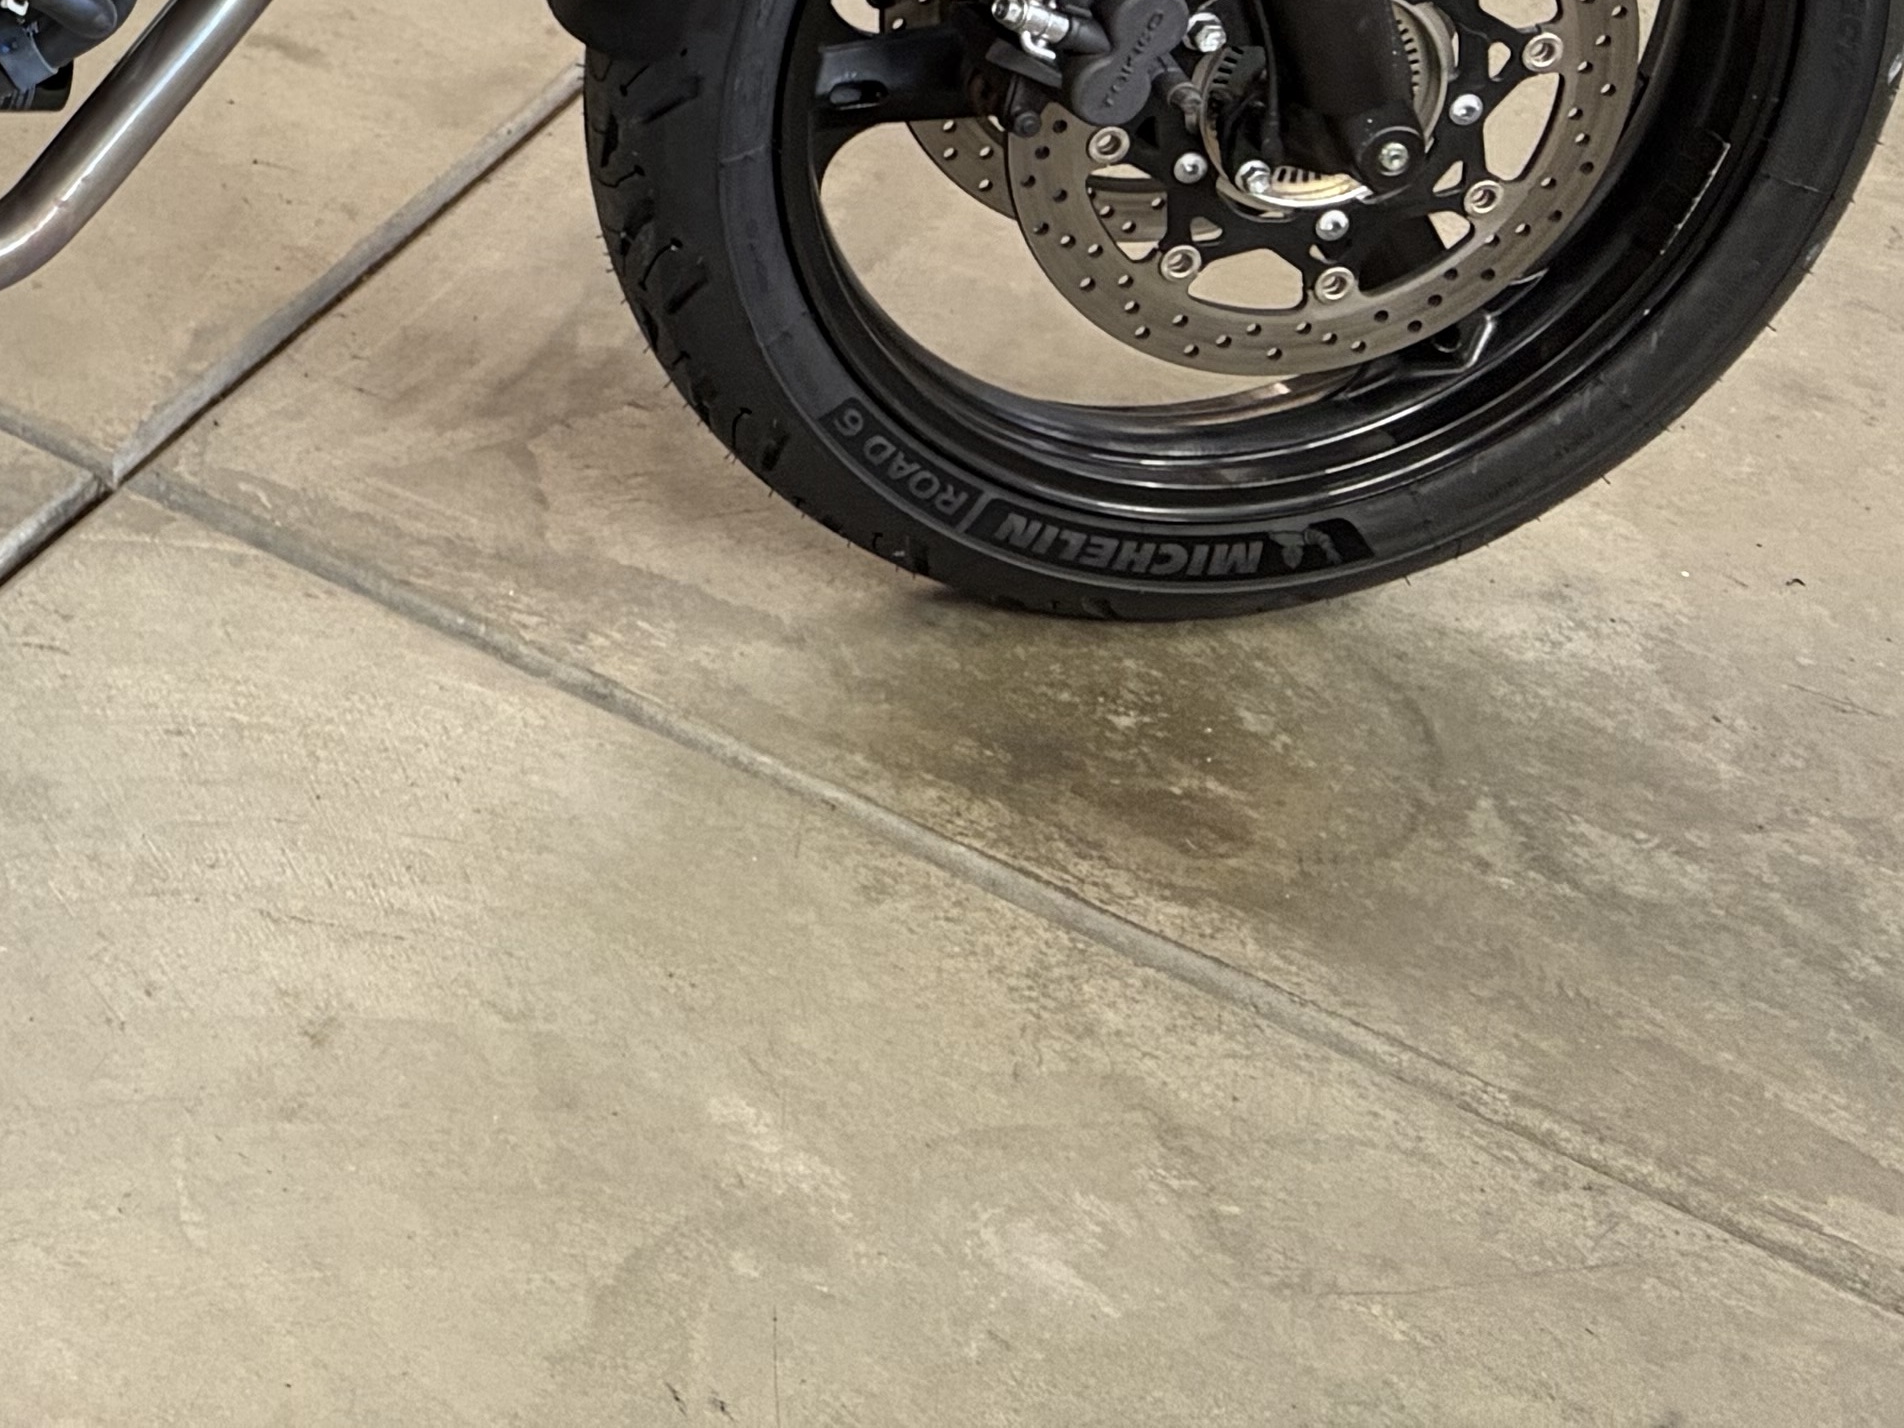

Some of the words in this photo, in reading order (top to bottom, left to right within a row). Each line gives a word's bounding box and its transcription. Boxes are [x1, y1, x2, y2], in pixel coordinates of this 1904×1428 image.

[833, 406, 865, 437] 6
[861, 436, 970, 516] ROAD
[993, 511, 1264, 576] MICHELIN
